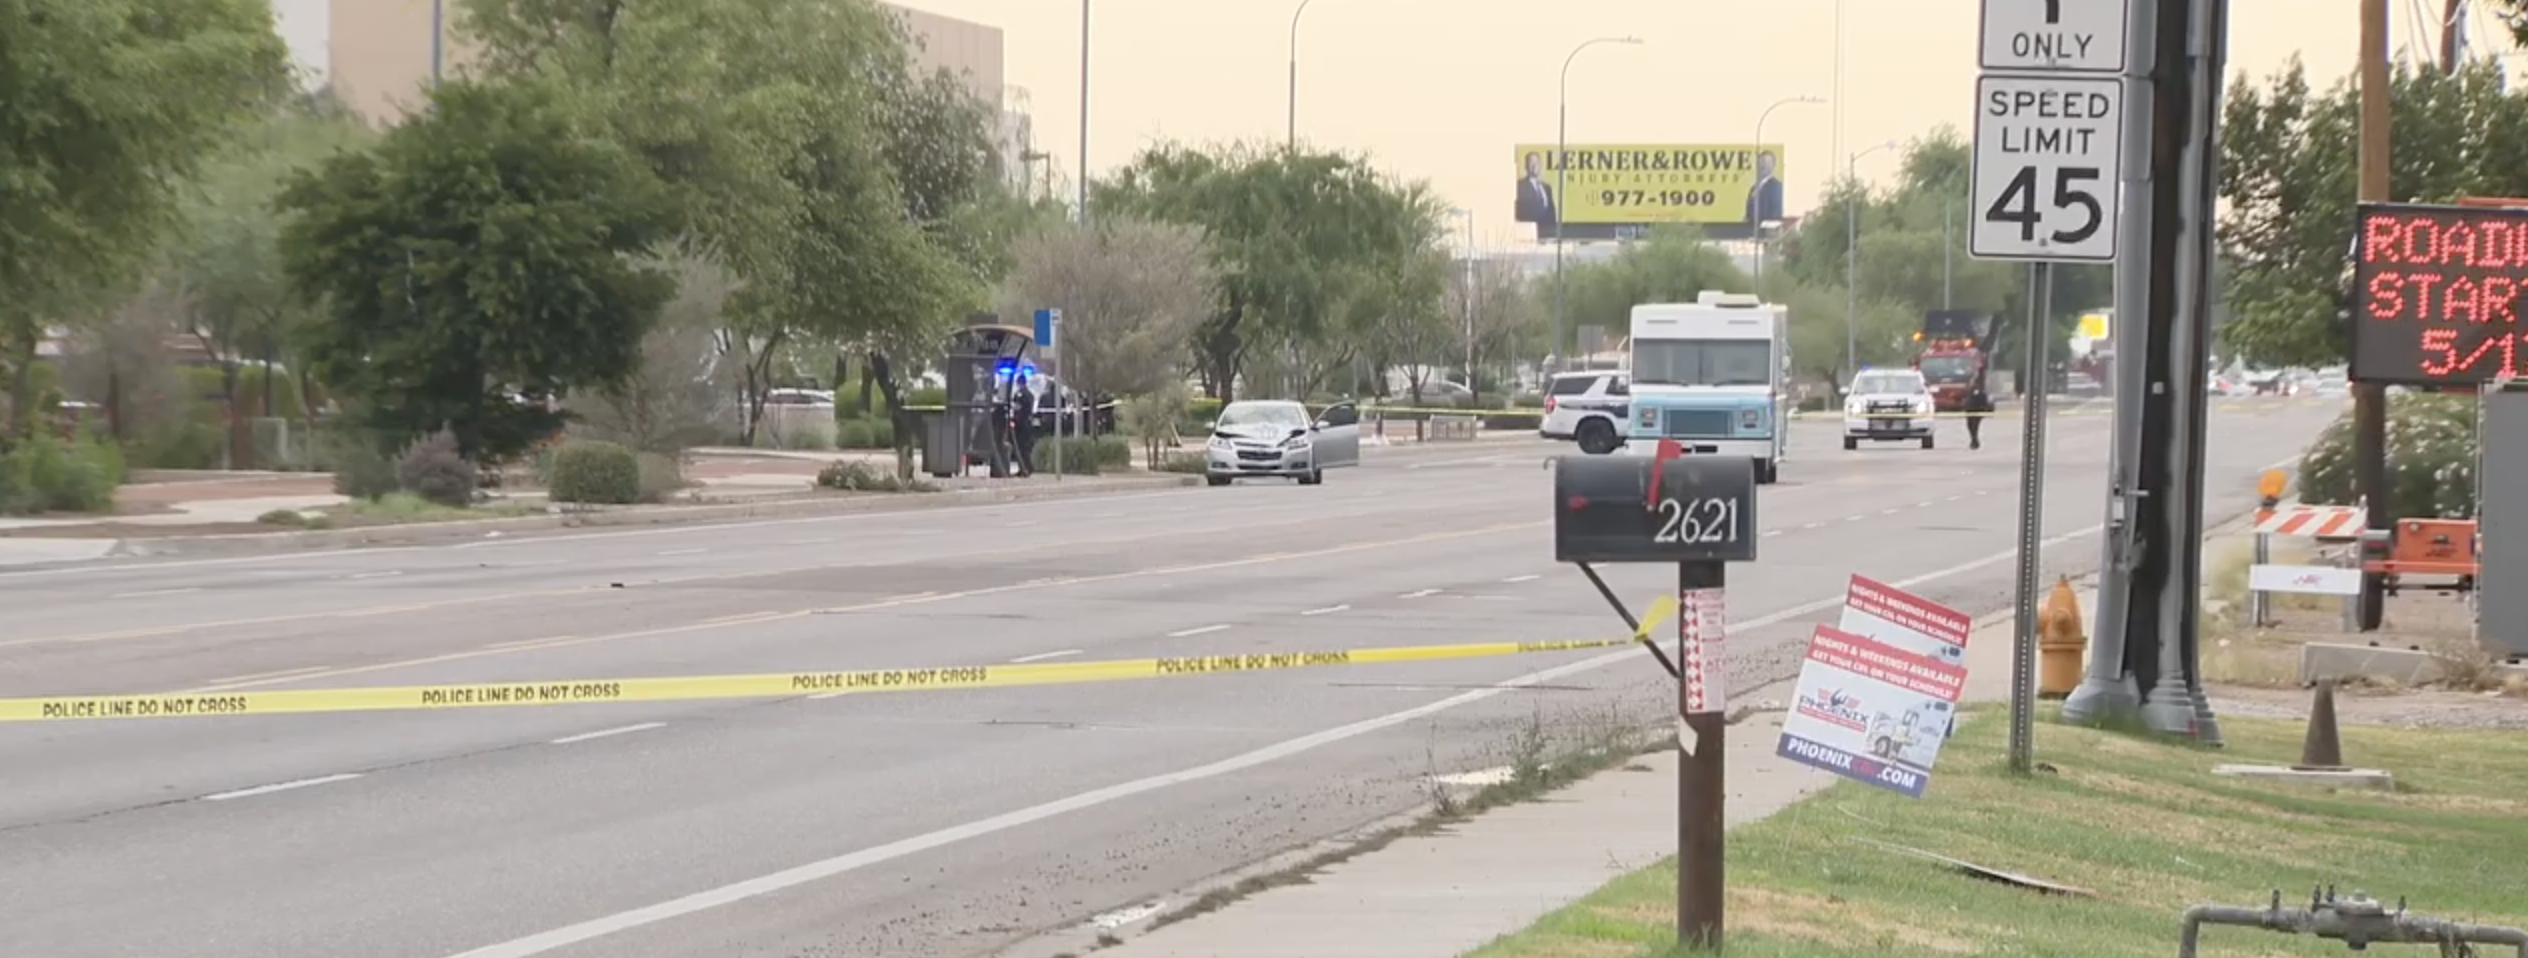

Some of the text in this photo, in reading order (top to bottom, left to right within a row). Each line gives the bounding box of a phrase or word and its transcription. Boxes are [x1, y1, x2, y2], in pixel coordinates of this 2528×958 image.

[2012, 33, 2093, 59] ONLY
[1989, 90, 2109, 119] SPEED
[2002, 126, 2095, 154] LIMIT
[1546, 149, 1752, 171] LERNER&ROWE
[1558, 173, 1621, 186] NJURY
[1601, 189, 1715, 207] 977-1900
[1986, 166, 2103, 244] 45
[2368, 272, 2528, 323] STAR
[2420, 329, 2528, 378] 5/1
[1654, 498, 1738, 543] 2621
[1156, 658, 1206, 674] POLICE
[1210, 656, 1241, 671] LINE
[1246, 654, 1266, 669] DO
[1271, 652, 1299, 668] NOT
[1910, 661, 1961, 687] AVAILABLE
[792, 667, 987, 690] POLICE LINE DO NOT CROSS
[43, 696, 247, 718] POLICE LINE DO NOT CROSS
[422, 683, 621, 705] POLICE LINE DO NOT CROSS
